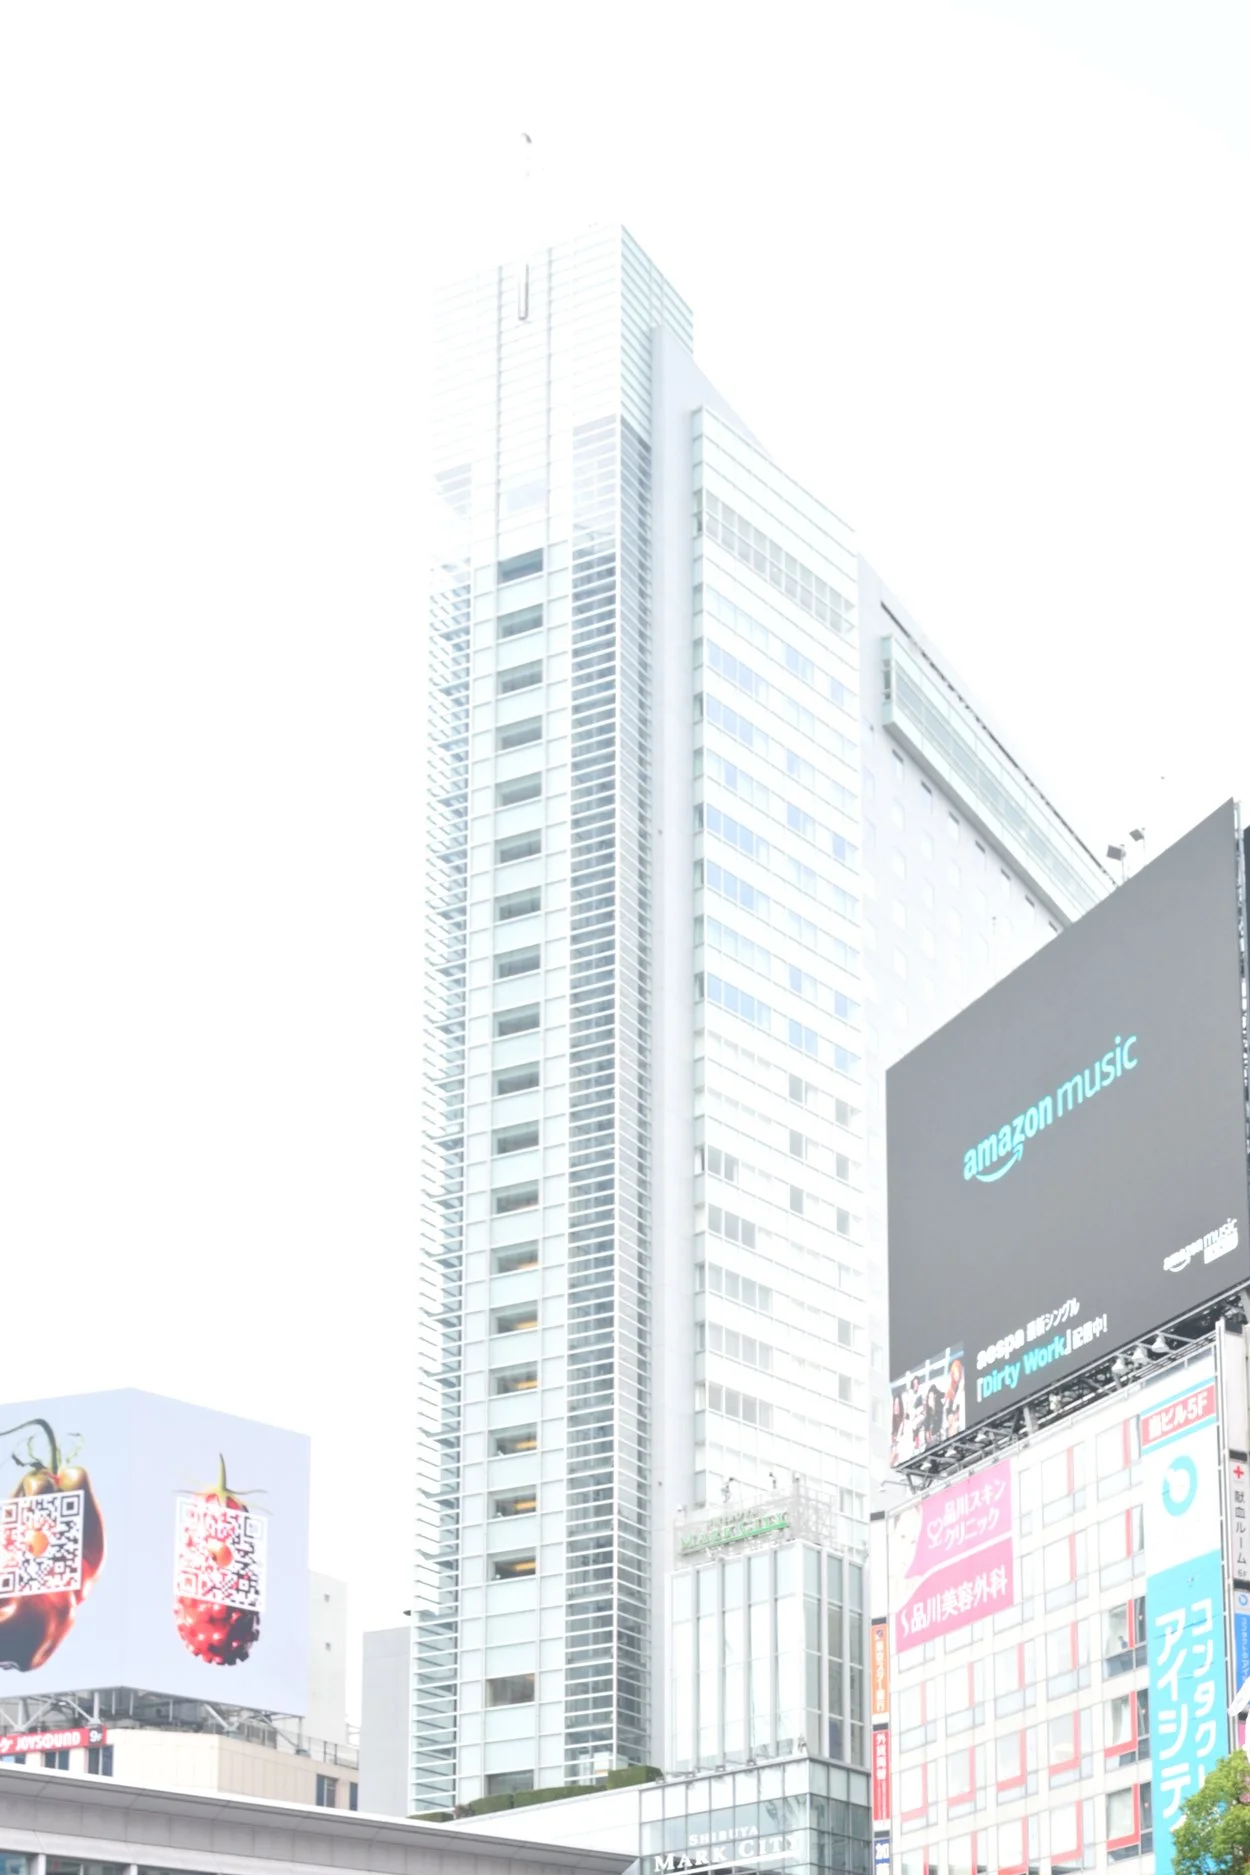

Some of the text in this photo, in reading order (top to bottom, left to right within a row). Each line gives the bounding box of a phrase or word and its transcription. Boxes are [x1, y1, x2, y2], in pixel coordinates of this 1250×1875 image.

[963, 1035, 1138, 1181] amazon music
[1203, 1218, 1238, 1250] music
[942, 1479, 1006, 1526] 品川スキン
[944, 1506, 999, 1551] クリニック
[911, 1565, 1007, 1633] 品川美容外科
[654, 1834, 799, 1872] MARK CITY
[689, 1825, 758, 1846] SHIBUYA
